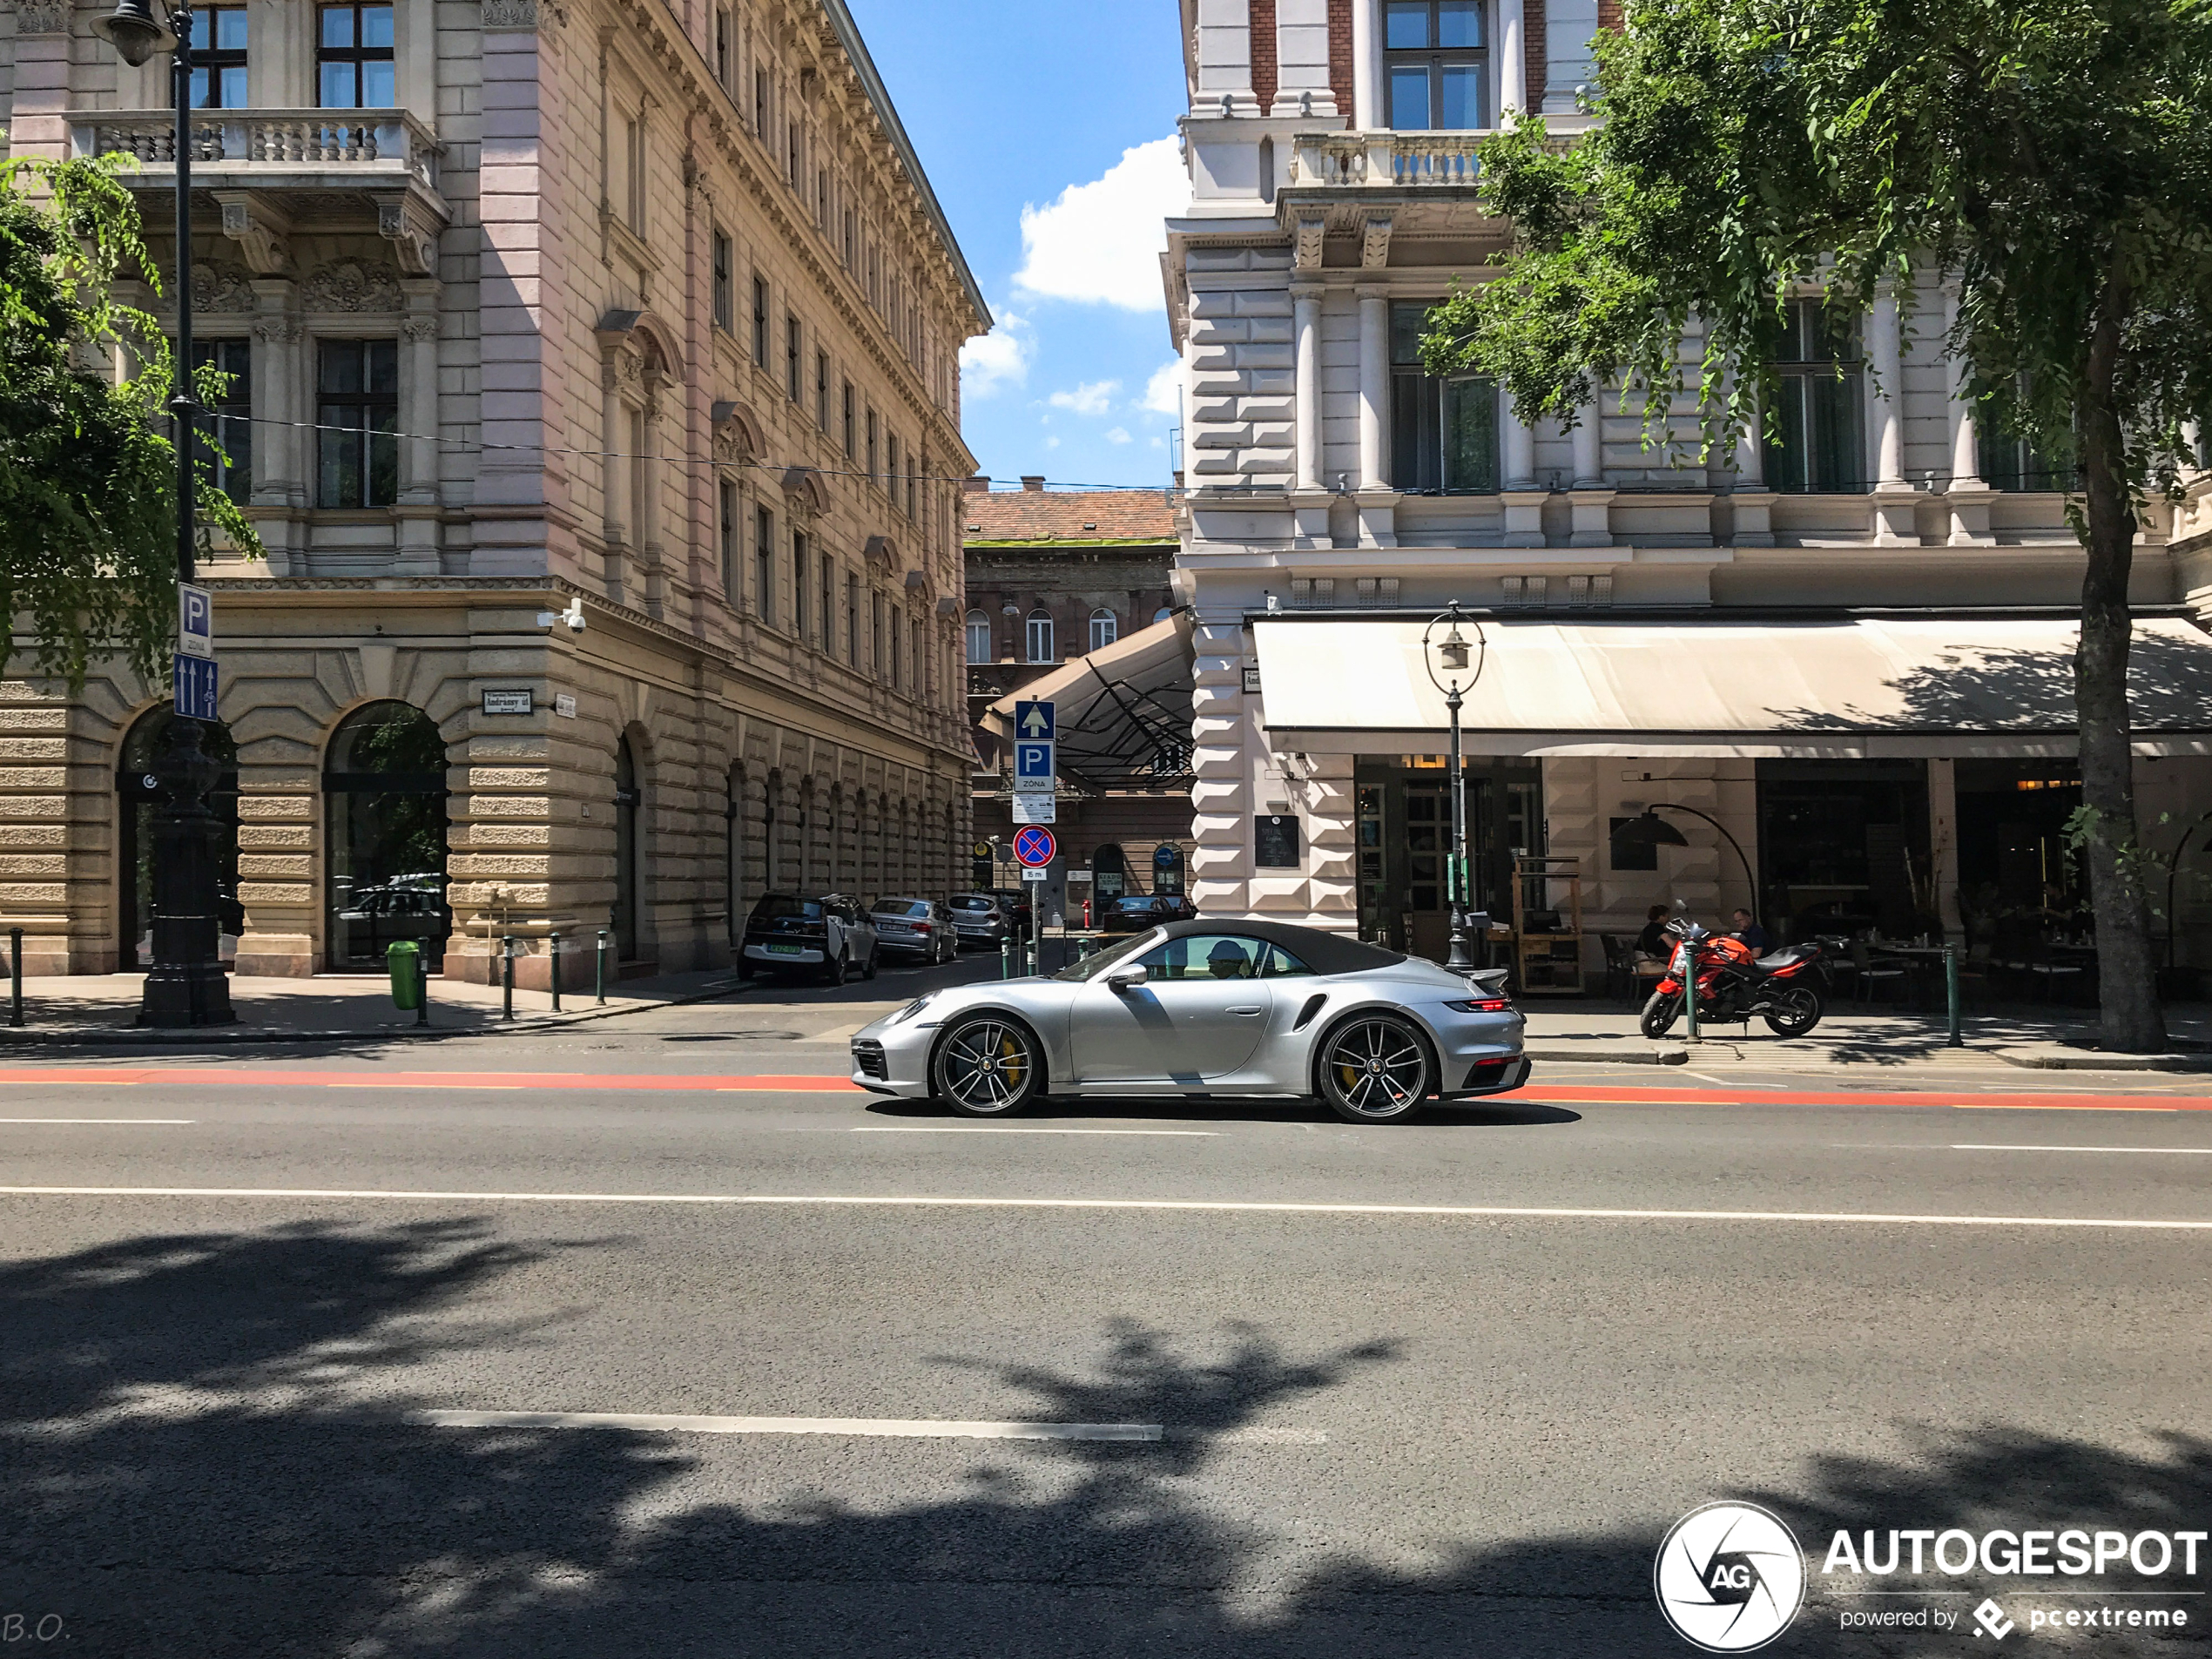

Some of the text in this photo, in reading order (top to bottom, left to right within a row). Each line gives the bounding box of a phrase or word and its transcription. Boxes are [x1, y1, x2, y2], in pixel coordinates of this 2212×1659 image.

[188, 596, 204, 631] P
[486, 698, 518, 708] Andrássy
[1025, 748, 1043, 772] P
